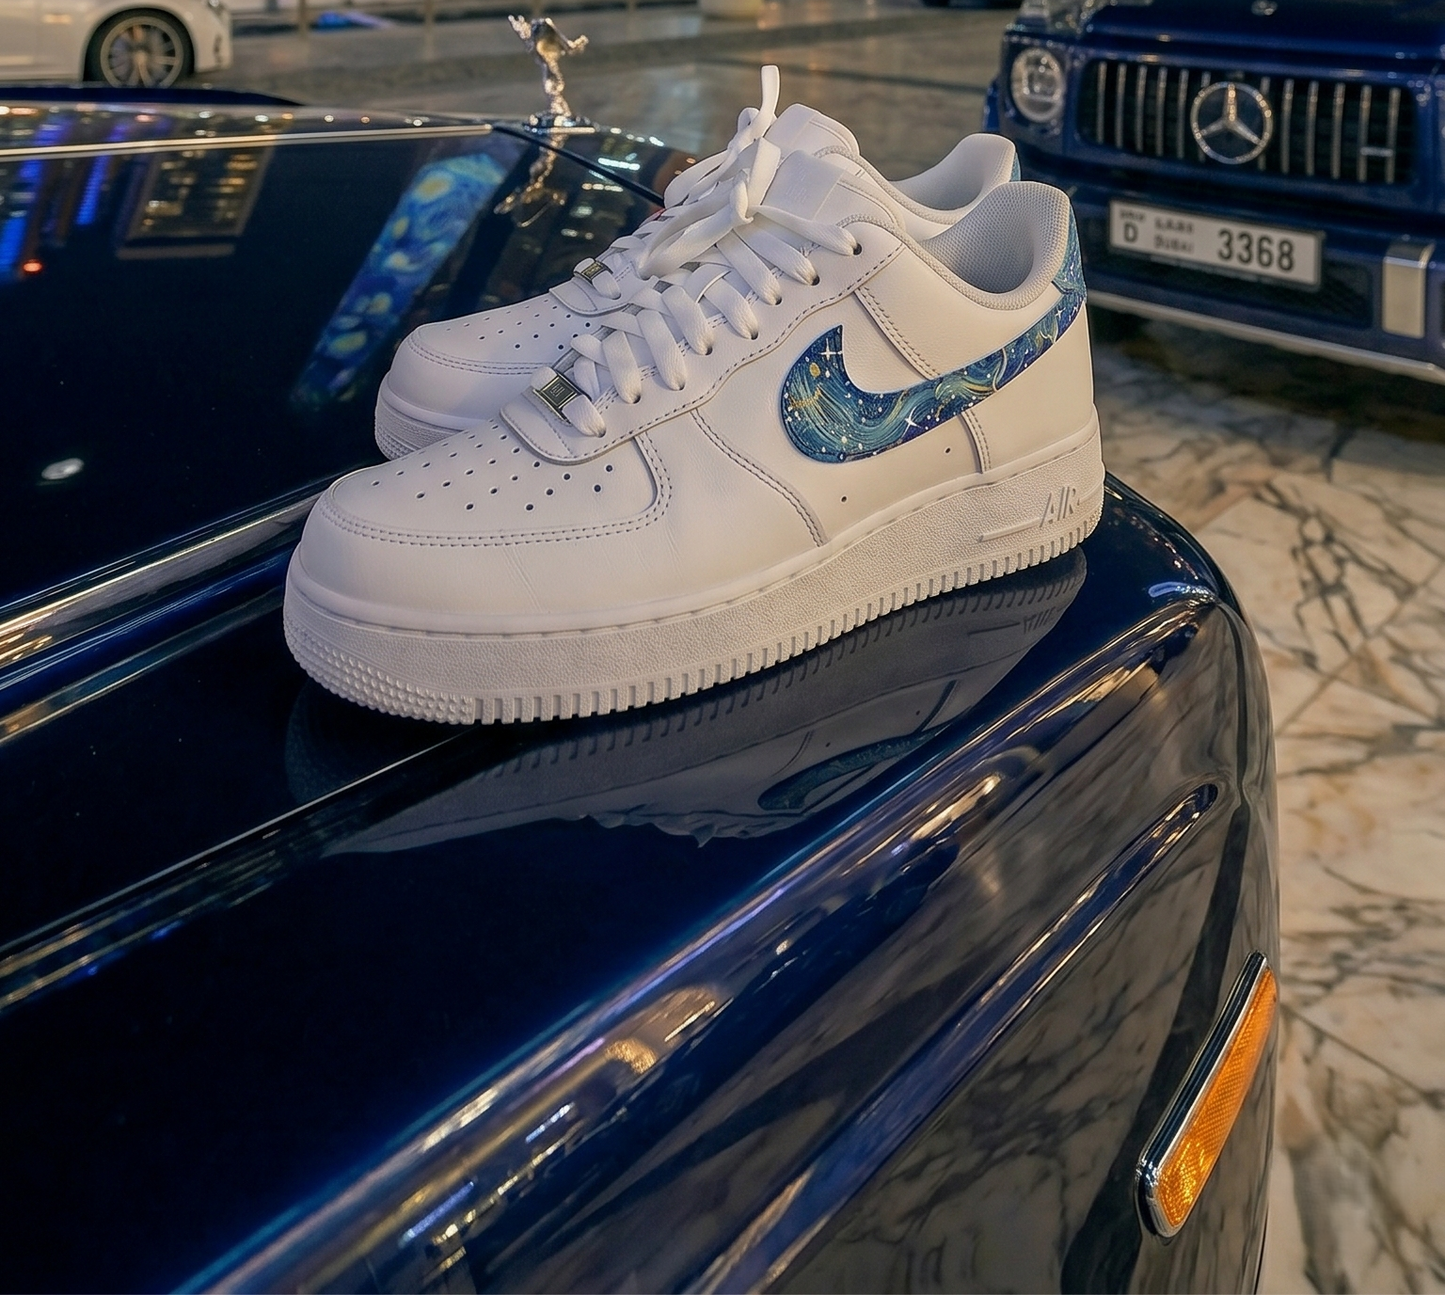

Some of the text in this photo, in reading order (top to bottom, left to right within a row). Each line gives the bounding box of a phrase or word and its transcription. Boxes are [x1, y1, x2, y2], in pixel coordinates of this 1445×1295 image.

[1124, 222, 1138, 243] D
[1218, 228, 1294, 272] 3368
[1040, 485, 1077, 526] AIR
